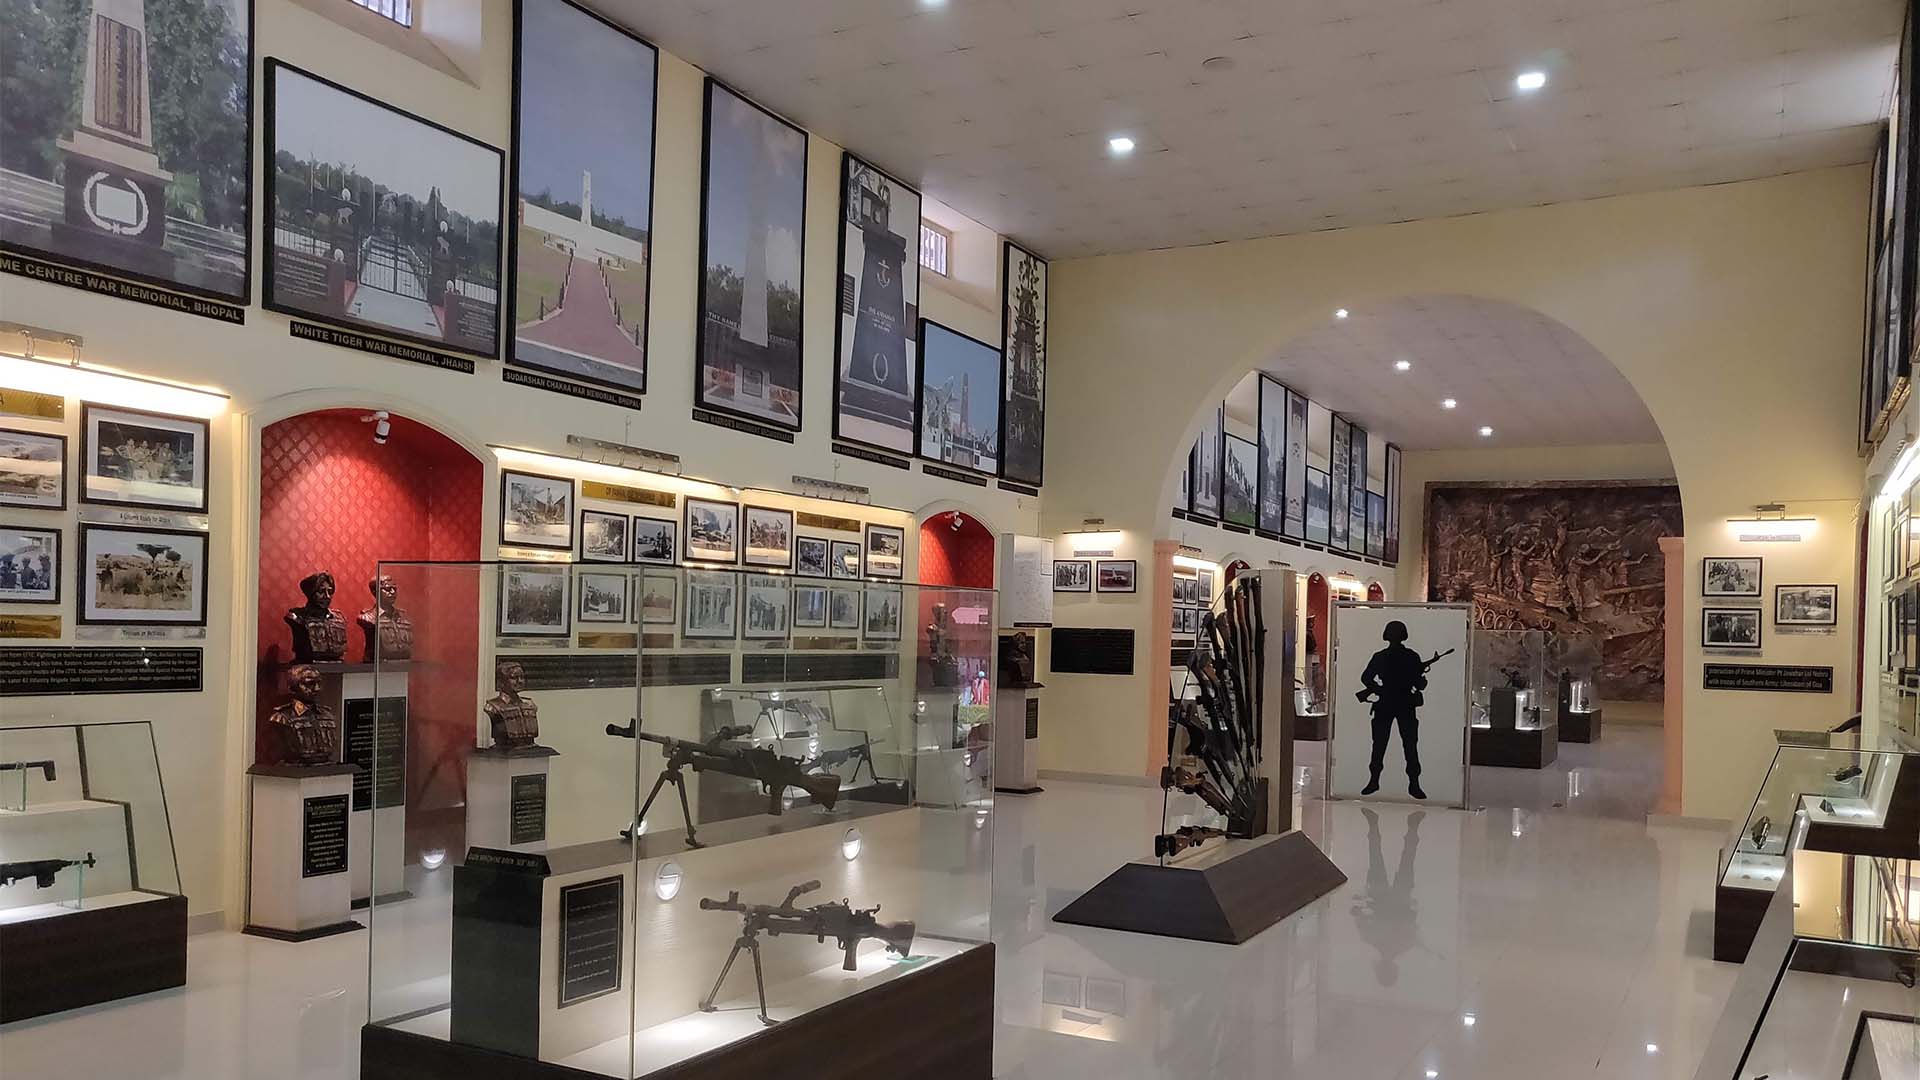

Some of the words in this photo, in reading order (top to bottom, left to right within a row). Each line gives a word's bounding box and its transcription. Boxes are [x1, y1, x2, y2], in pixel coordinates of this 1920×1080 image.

[26, 263, 82, 285] CENTRE
[87, 276, 117, 293] WAR
[121, 285, 191, 311] MEMORIAL,
[194, 302, 240, 321] BHOPAL
[294, 323, 329, 341] WHITE
[332, 332, 363, 348] TIGER
[365, 340, 387, 353] WAR
[389, 345, 439, 365] MEMORIAL,
[441, 357, 472, 371] JHANSI
[506, 371, 545, 387] SUDARSHAN
[546, 379, 571, 393] CHAKRA
[572, 385, 586, 396] WAR
[1741, 668, 1755, 676] Prime
